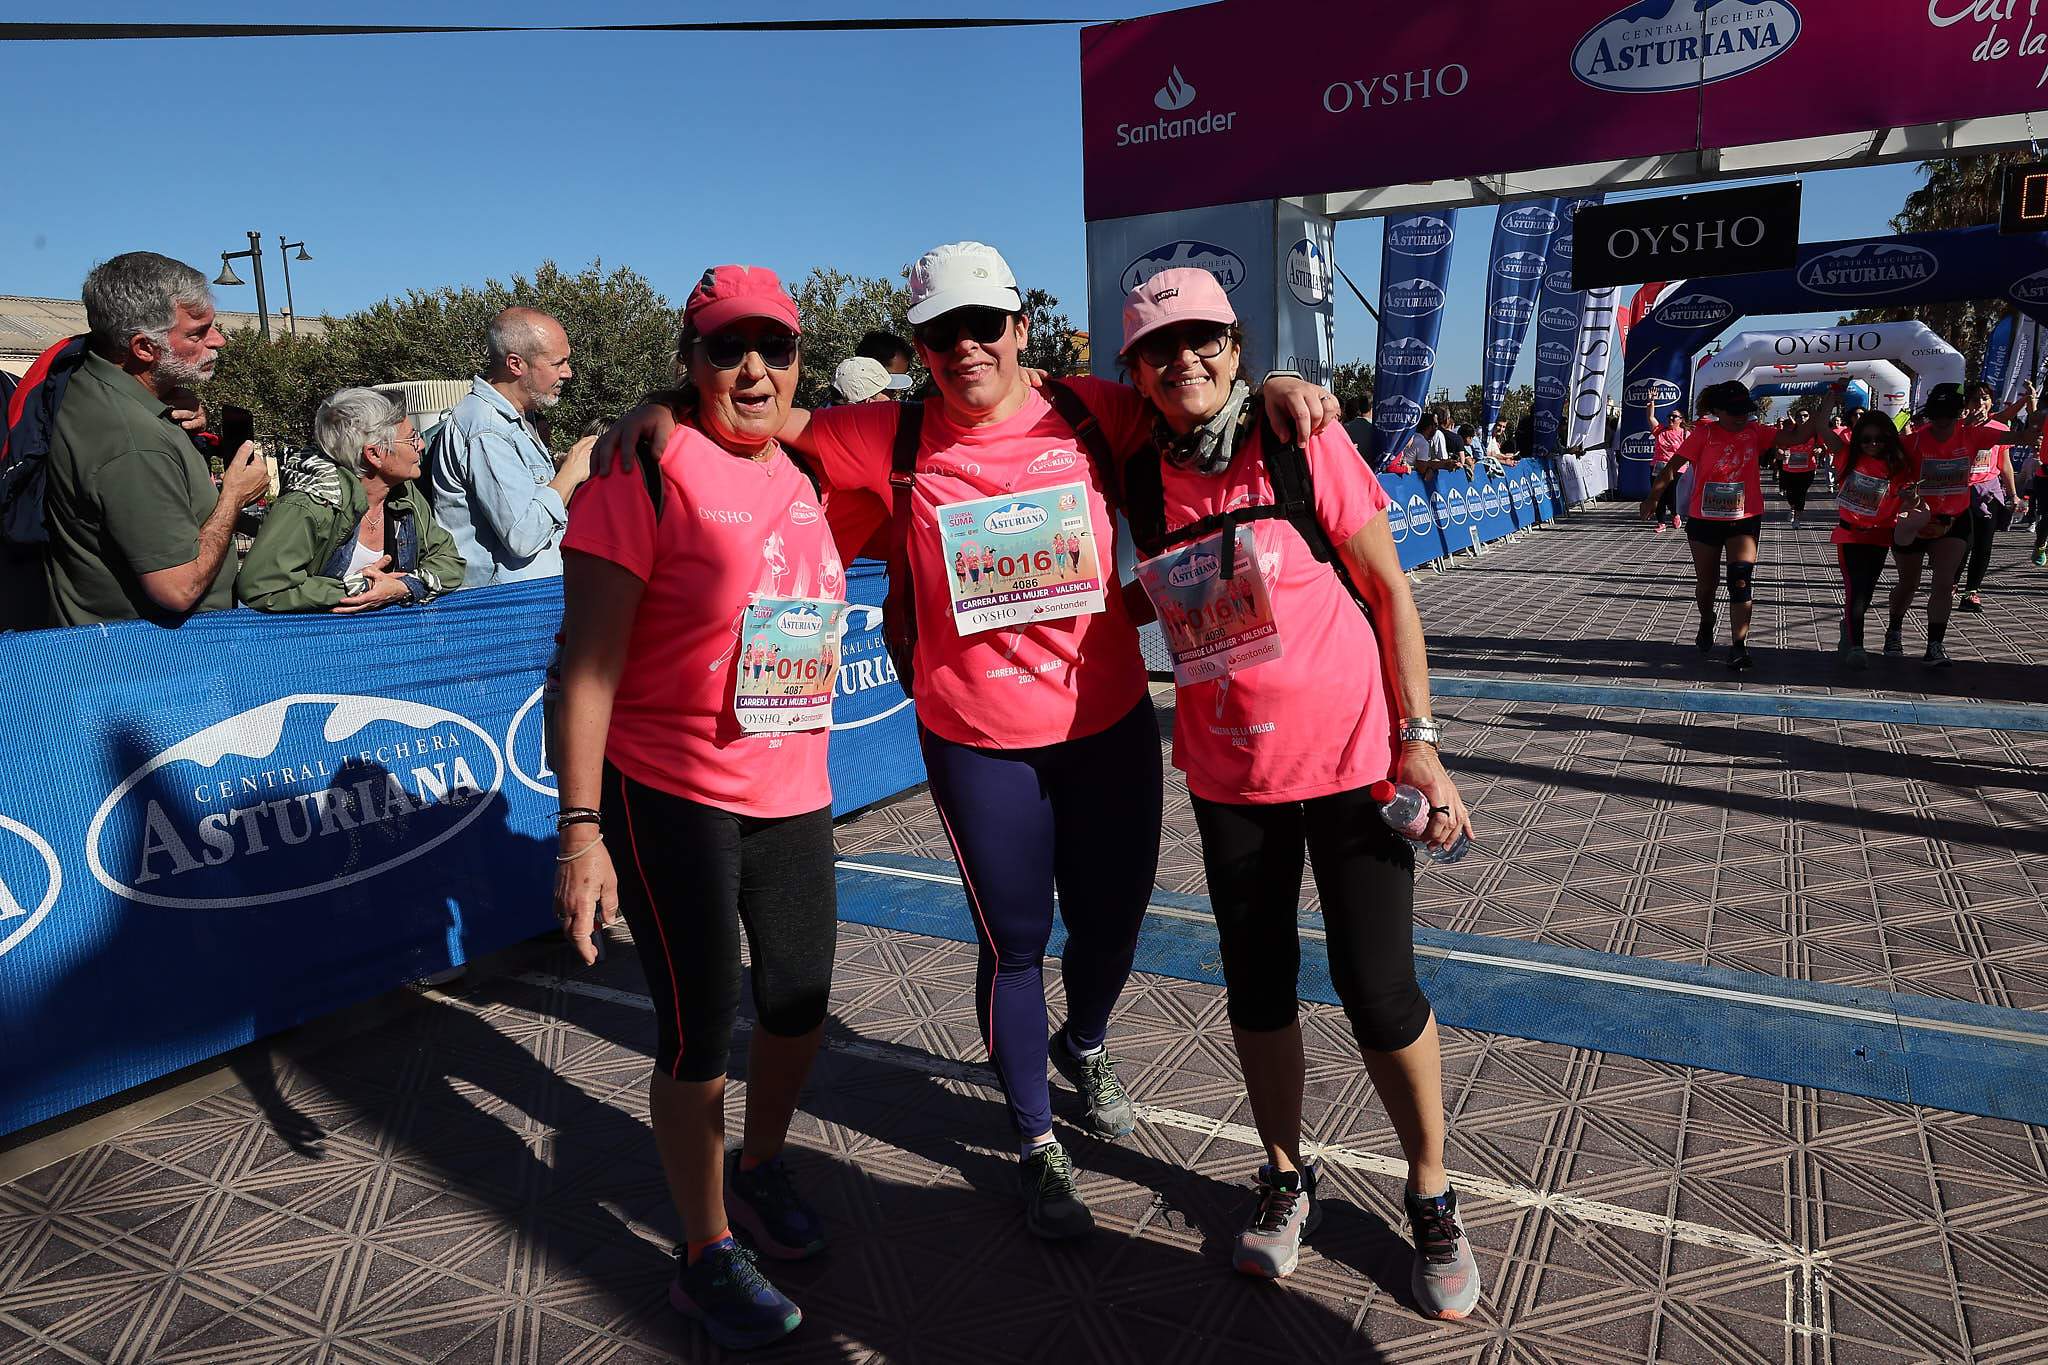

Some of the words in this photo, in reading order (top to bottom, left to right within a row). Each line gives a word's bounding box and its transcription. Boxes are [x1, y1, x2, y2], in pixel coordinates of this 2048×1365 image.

[1622, 22, 1692, 41] CENTRAL
[1972, 24, 2010, 62] de
[2019, 17, 2047, 57] la
[1587, 22, 1781, 76] ASTURIANA
[1323, 63, 1468, 113] OYSHO
[1116, 110, 1237, 147] Santander
[1607, 216, 1766, 259] OYSHO
[1806, 262, 1927, 286] ASTURIANA
[1660, 308, 1726, 321] ASTURIANA
[1774, 331, 1882, 356] OYSHO
[1911, 348, 1946, 358] OYSHO
[1713, 361, 1744, 369] OYSHO
[698, 506, 753, 523] OYSHO
[949, 517, 974, 528] SUMA
[990, 514, 1044, 530] ASTURIANA
[997, 550, 1052, 577] 016
[1172, 560, 1218, 586] ASTURIANA
[1012, 579, 1039, 590] 4086
[962, 597, 997, 610] CARRERA
[999, 594, 1010, 603] DE
[1011, 592, 1022, 601] LA
[1022, 589, 1049, 600] MUJER
[1055, 581, 1092, 594] VALENCIA
[1045, 599, 1088, 614] Santander
[972, 608, 1017, 625] OYSHO
[1206, 645, 1214, 654] LA
[1215, 637, 1237, 651] MUJER
[1241, 625, 1274, 641] VALENCIA
[1235, 644, 1275, 663] Santander
[776, 658, 818, 680] 016
[986, 665, 1018, 679] CARRERA
[1040, 659, 1063, 672] MUJER
[784, 685, 804, 695] 4087
[740, 698, 769, 706] CARRERA
[770, 698, 779, 706] DE
[780, 698, 787, 706] LA
[789, 697, 807, 705] MUJER
[744, 713, 781, 724] OYSHO
[1249, 722, 1276, 735] MUJER
[194, 759, 331, 804] CENTRAL
[342, 731, 462, 769] LECHERA
[134, 756, 485, 886] ASTURIANA
